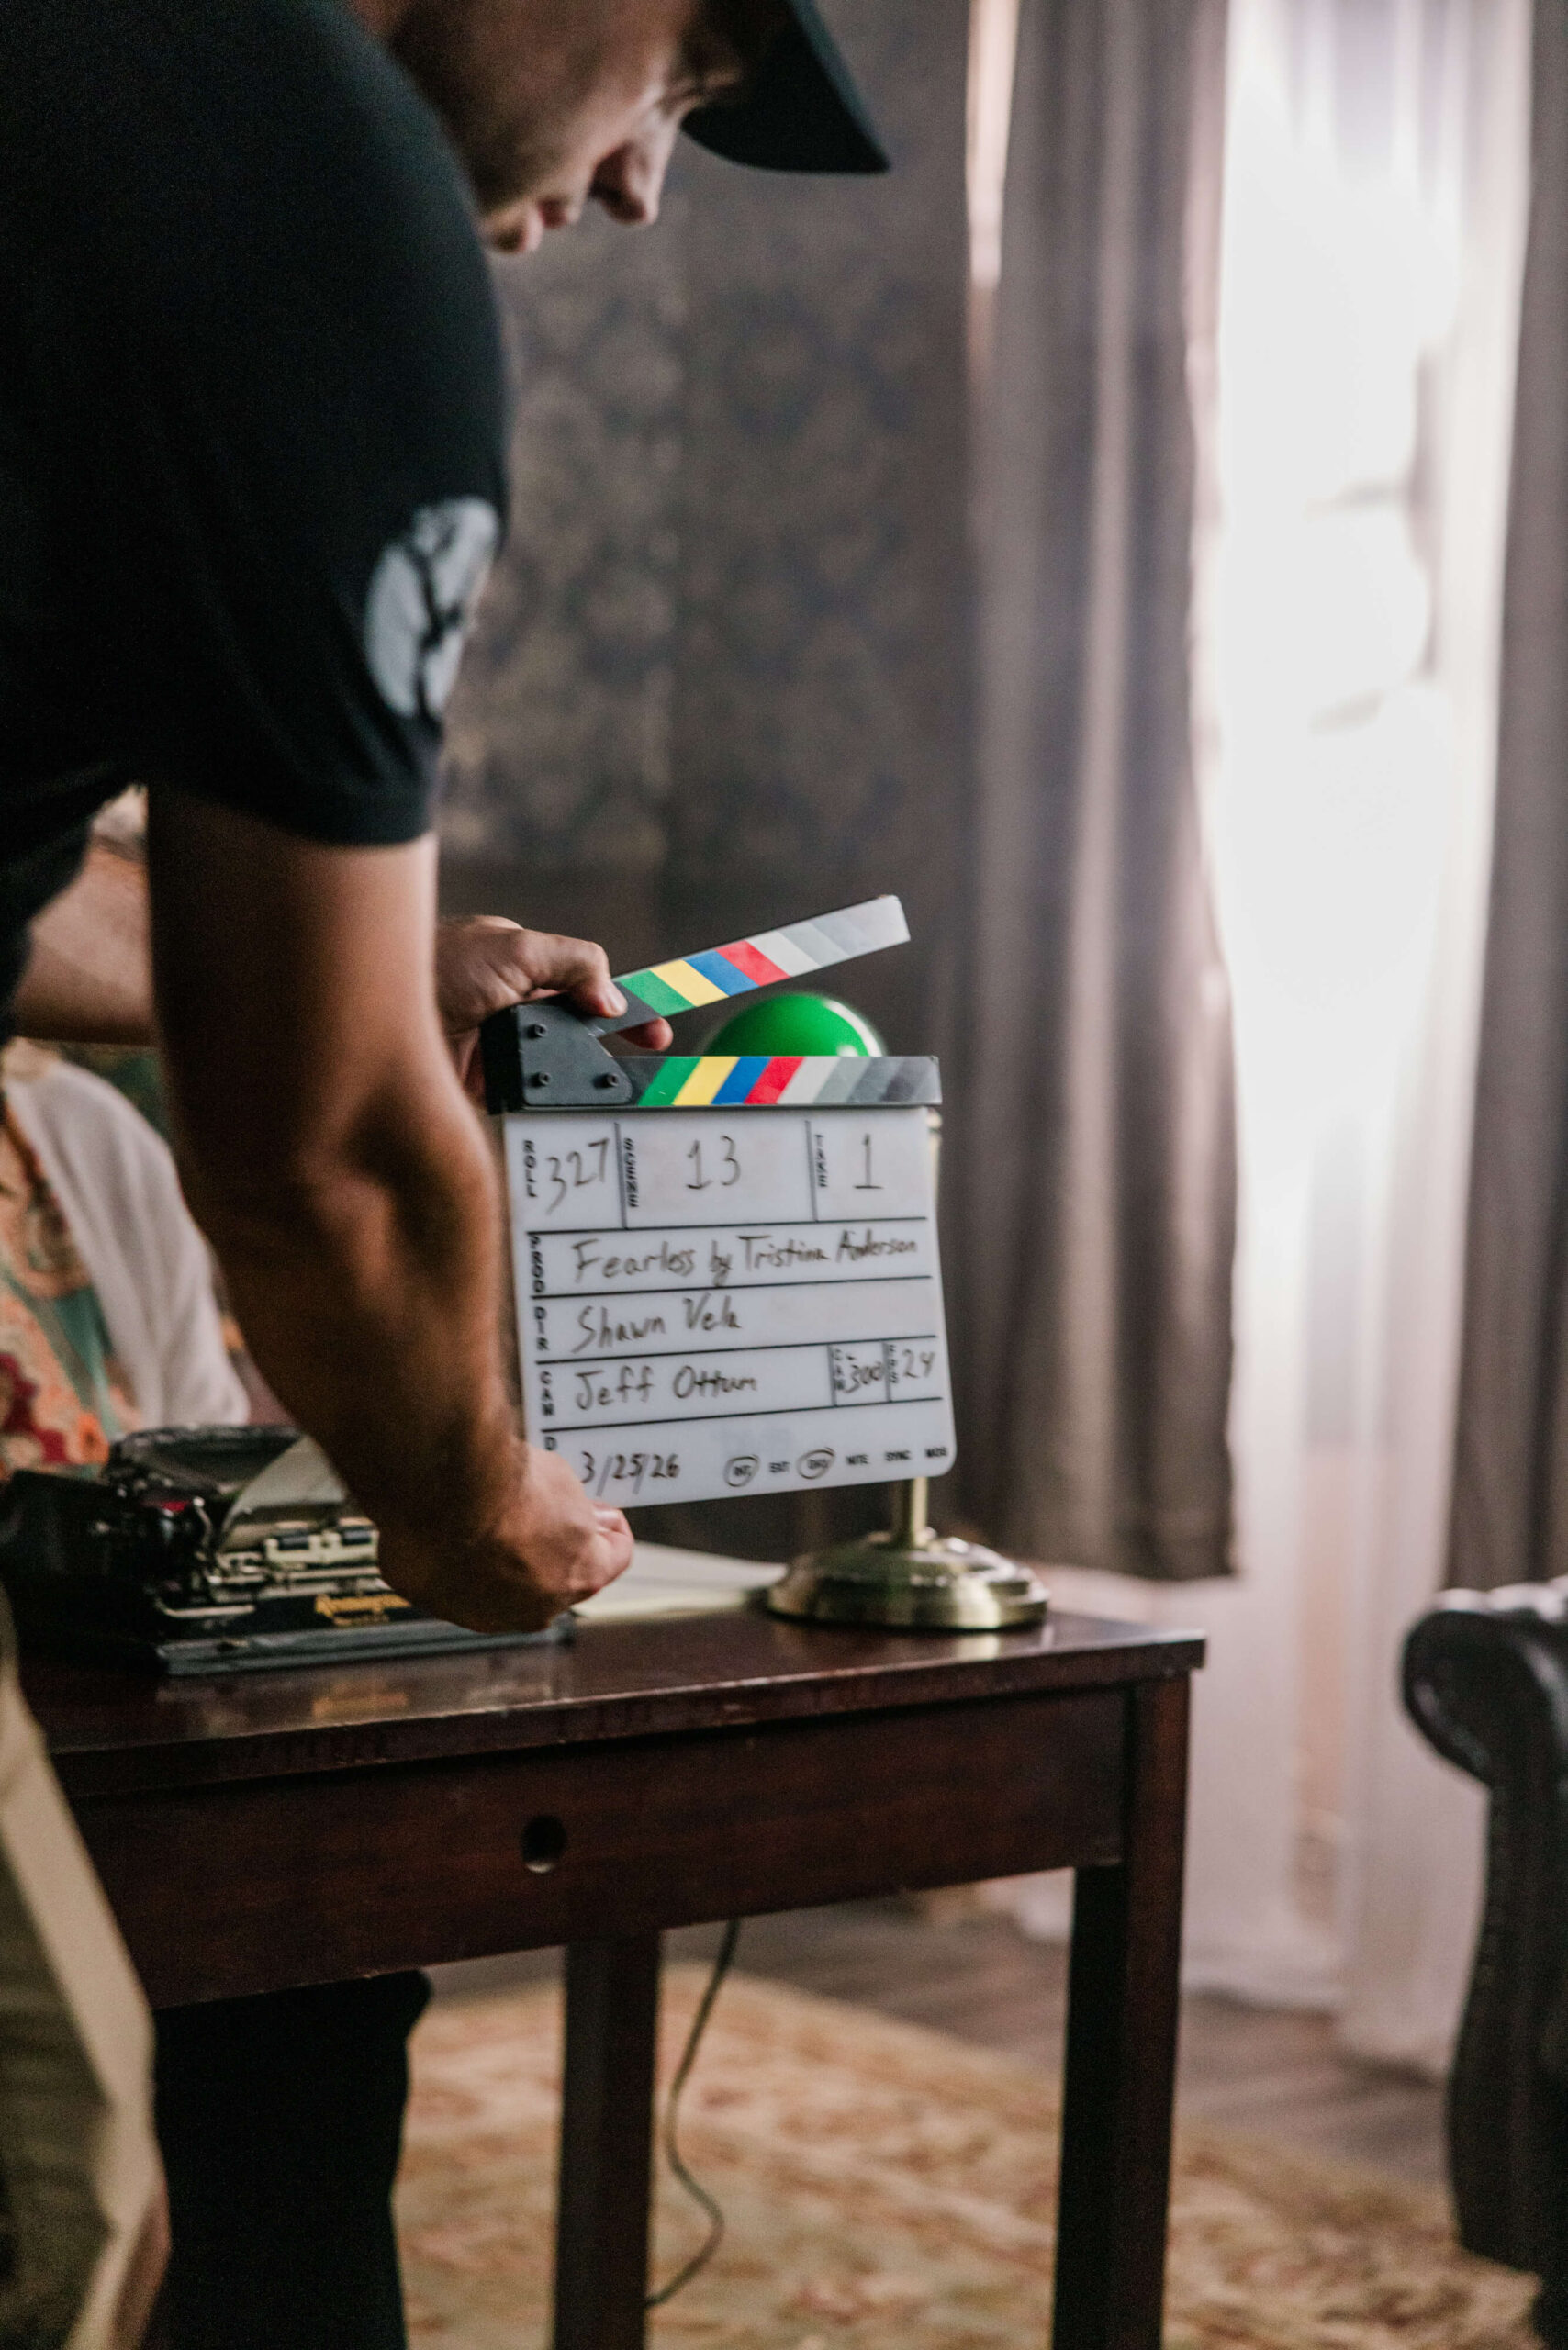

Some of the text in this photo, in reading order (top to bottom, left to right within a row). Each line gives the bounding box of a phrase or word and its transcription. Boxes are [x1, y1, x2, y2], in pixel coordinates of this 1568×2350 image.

[522, 1138, 538, 1198] ROLL
[546, 1137, 610, 1214] 327
[623, 1137, 639, 1208] SCENE
[686, 1135, 741, 1190] 13
[814, 1134, 827, 1188] TAKE
[854, 1133, 884, 1190] 1
[530, 1235, 546, 1293] PROD
[570, 1238, 695, 1283] Fearless
[708, 1239, 733, 1286] by
[533, 1306, 548, 1351] DIR
[571, 1292, 742, 1355] Shawn Vela
[575, 1365, 655, 1410] Jeff
[902, 1348, 936, 1379] 24
[580, 1450, 681, 1497] 3/25/26
